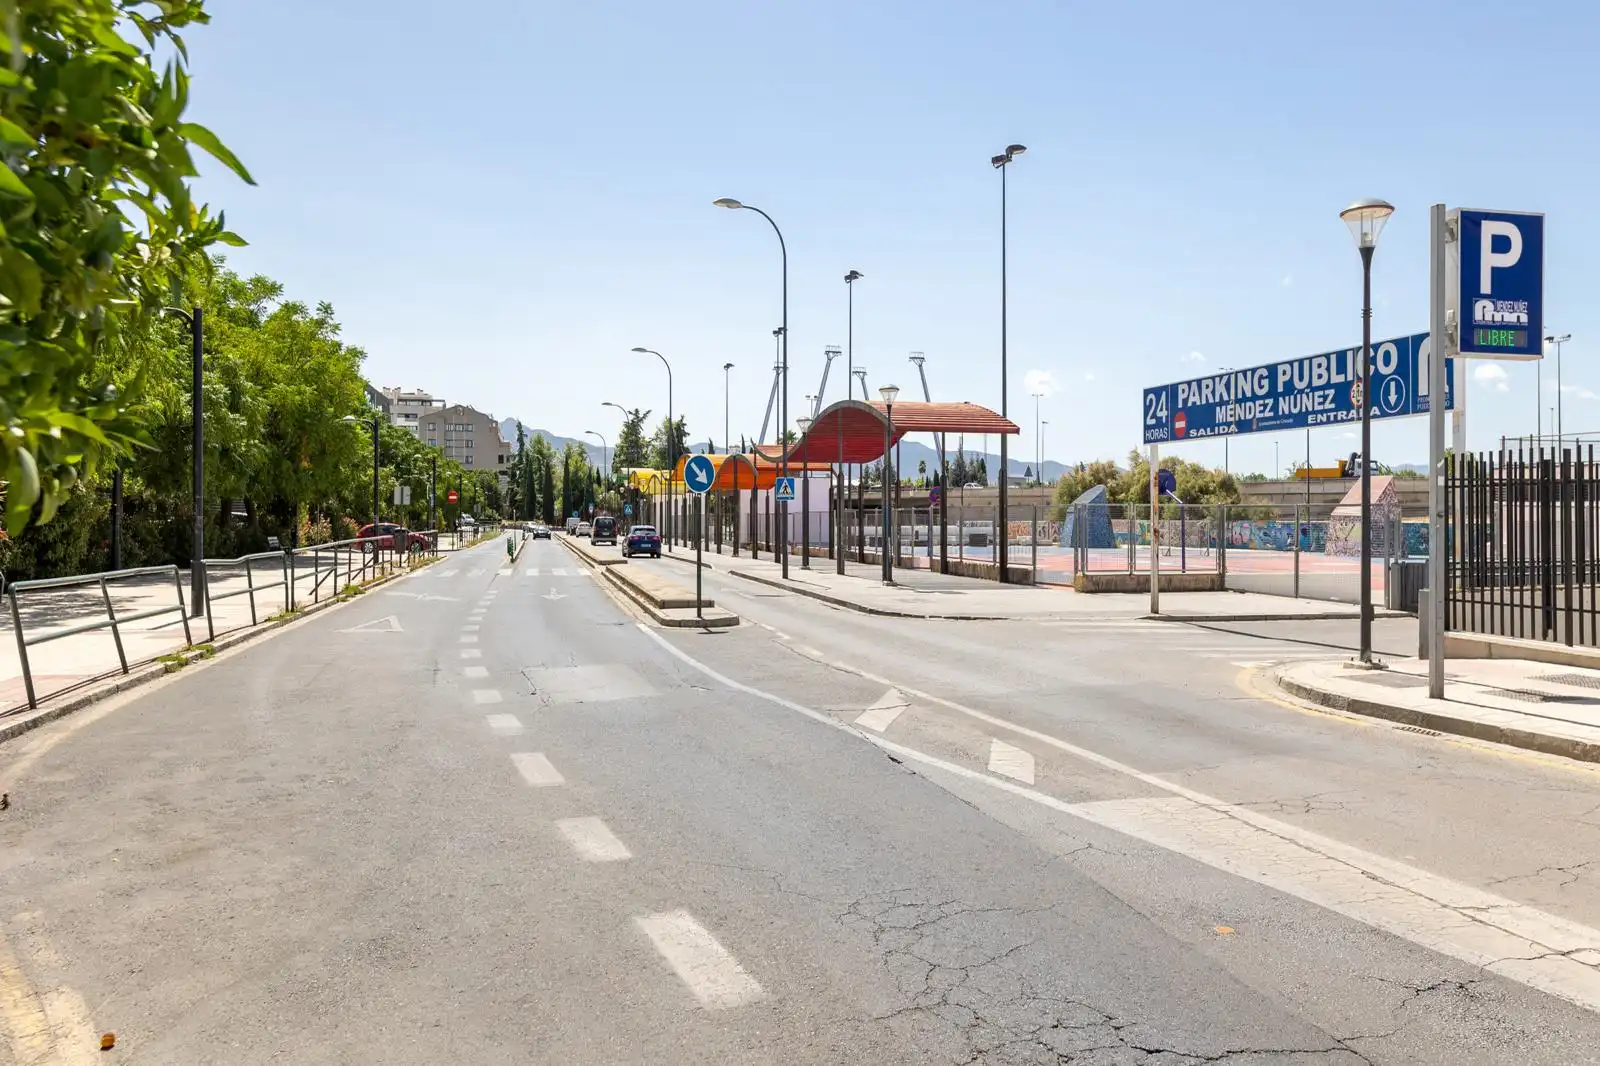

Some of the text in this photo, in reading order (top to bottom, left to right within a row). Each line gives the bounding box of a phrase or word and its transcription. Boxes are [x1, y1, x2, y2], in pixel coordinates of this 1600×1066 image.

[1480, 220, 1523, 295] P
[1480, 329, 1515, 347] LIBRE
[1177, 342, 1398, 408] PARKING PUBLICO
[1146, 390, 1168, 425] 24
[1215, 388, 1336, 423] MÉNDEZ NÚÑEZ
[1145, 427, 1168, 441] HORAS
[1189, 424, 1239, 437] SALIDA
